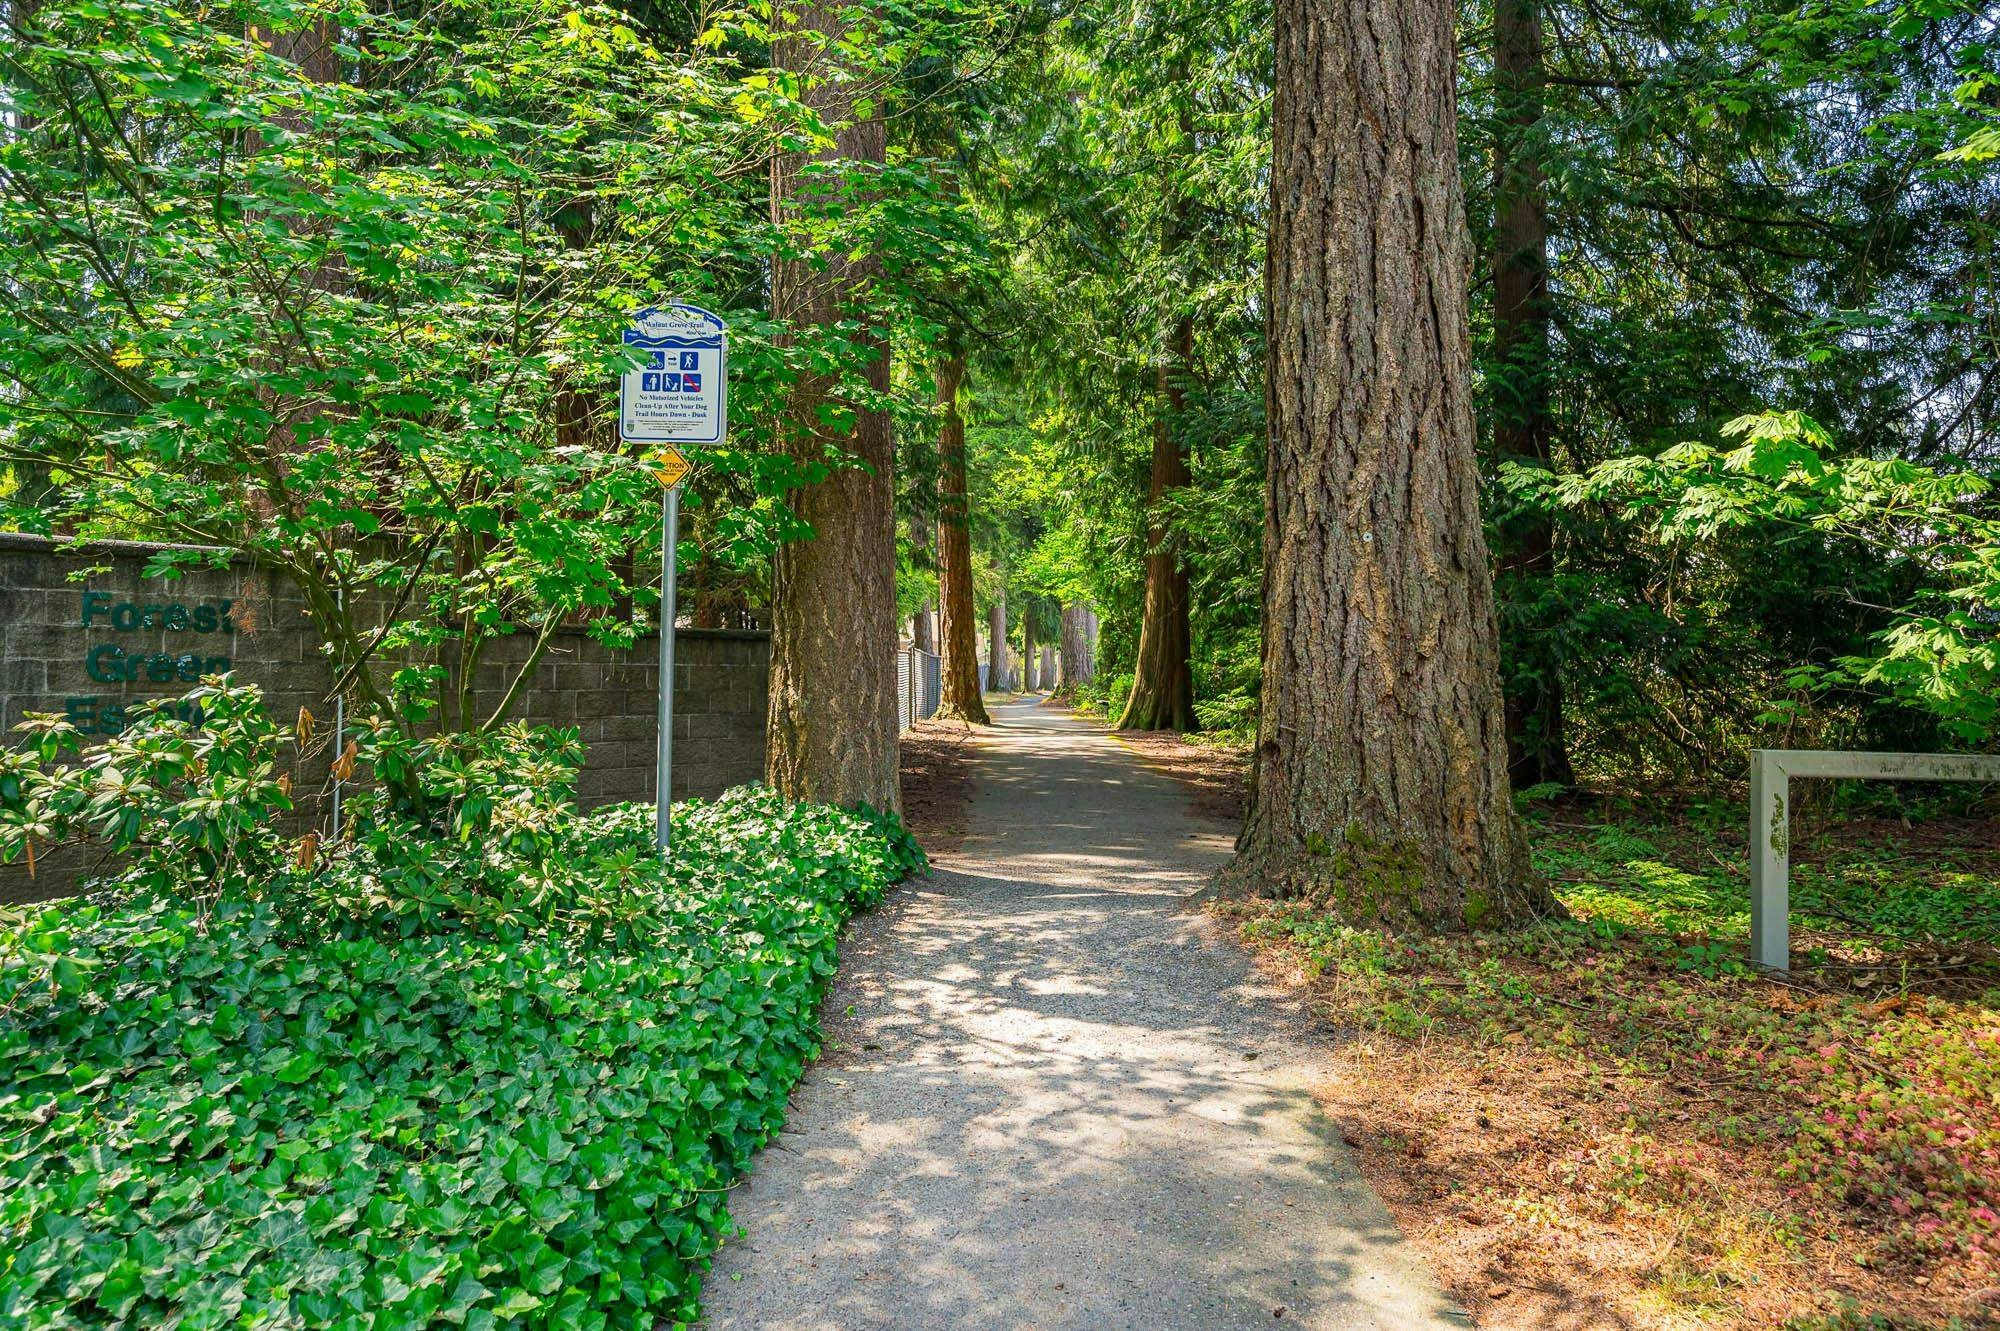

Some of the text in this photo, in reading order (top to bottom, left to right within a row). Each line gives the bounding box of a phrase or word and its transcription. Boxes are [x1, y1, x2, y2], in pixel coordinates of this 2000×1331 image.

[634, 403, 662, 411] Clean-Up
[81, 591, 235, 634] Forest
[86, 643, 231, 683] Green
